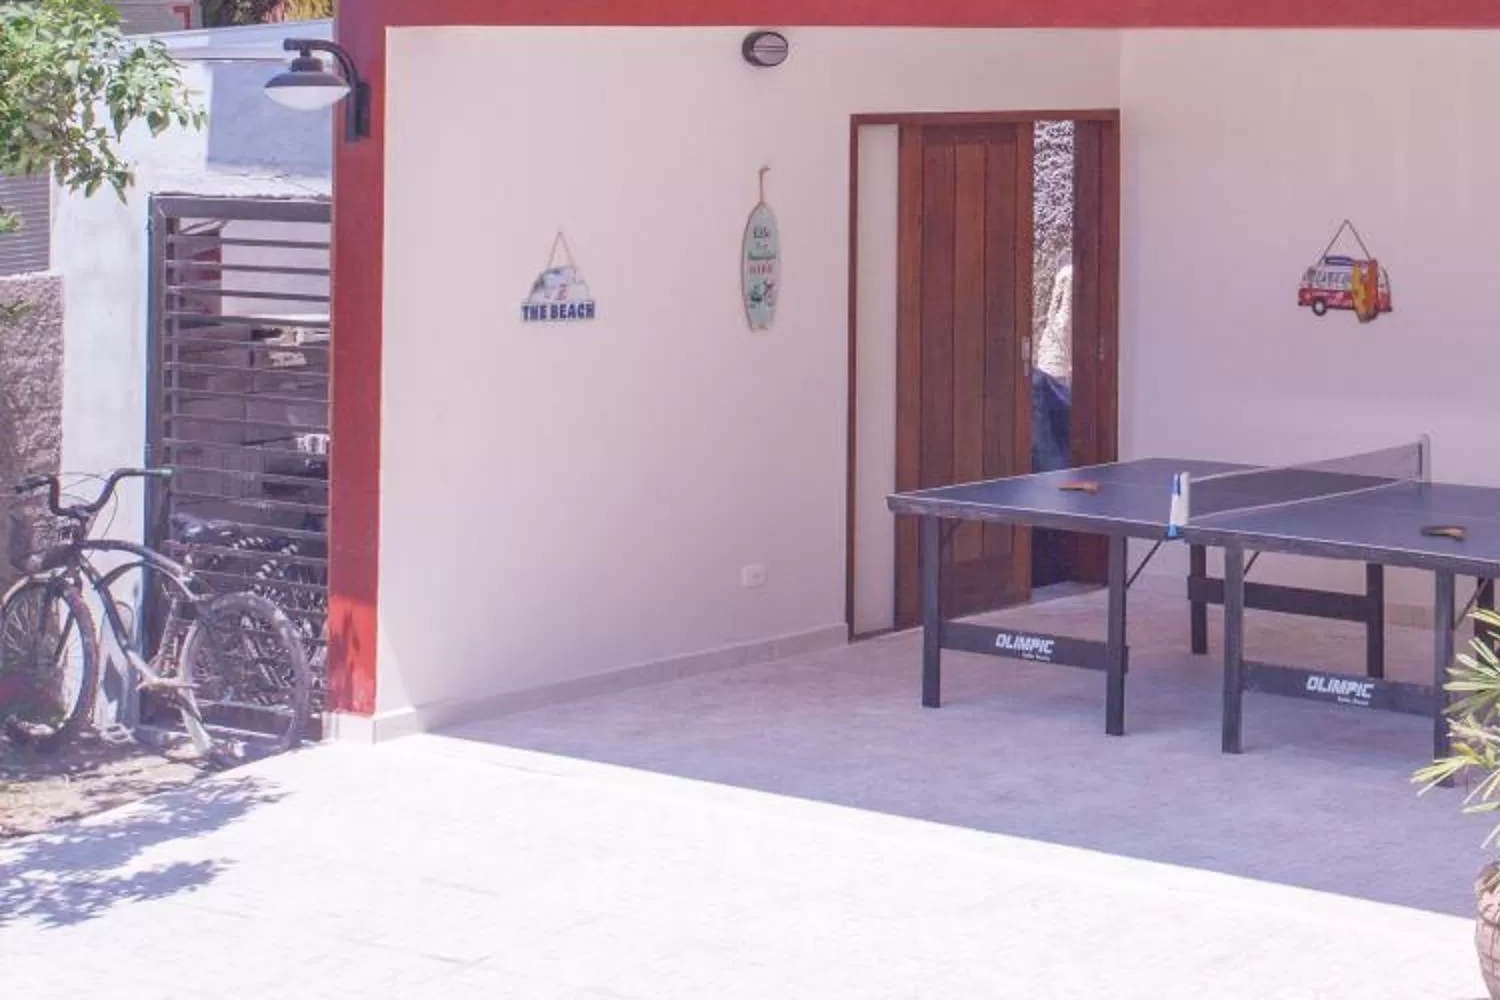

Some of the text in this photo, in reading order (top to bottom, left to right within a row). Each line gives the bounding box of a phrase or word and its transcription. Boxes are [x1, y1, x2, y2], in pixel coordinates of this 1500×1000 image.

[522, 302, 594, 321] THE BEACH
[995, 633, 1055, 654] OLIMPIC
[1306, 676, 1375, 698] OLIMPIC
